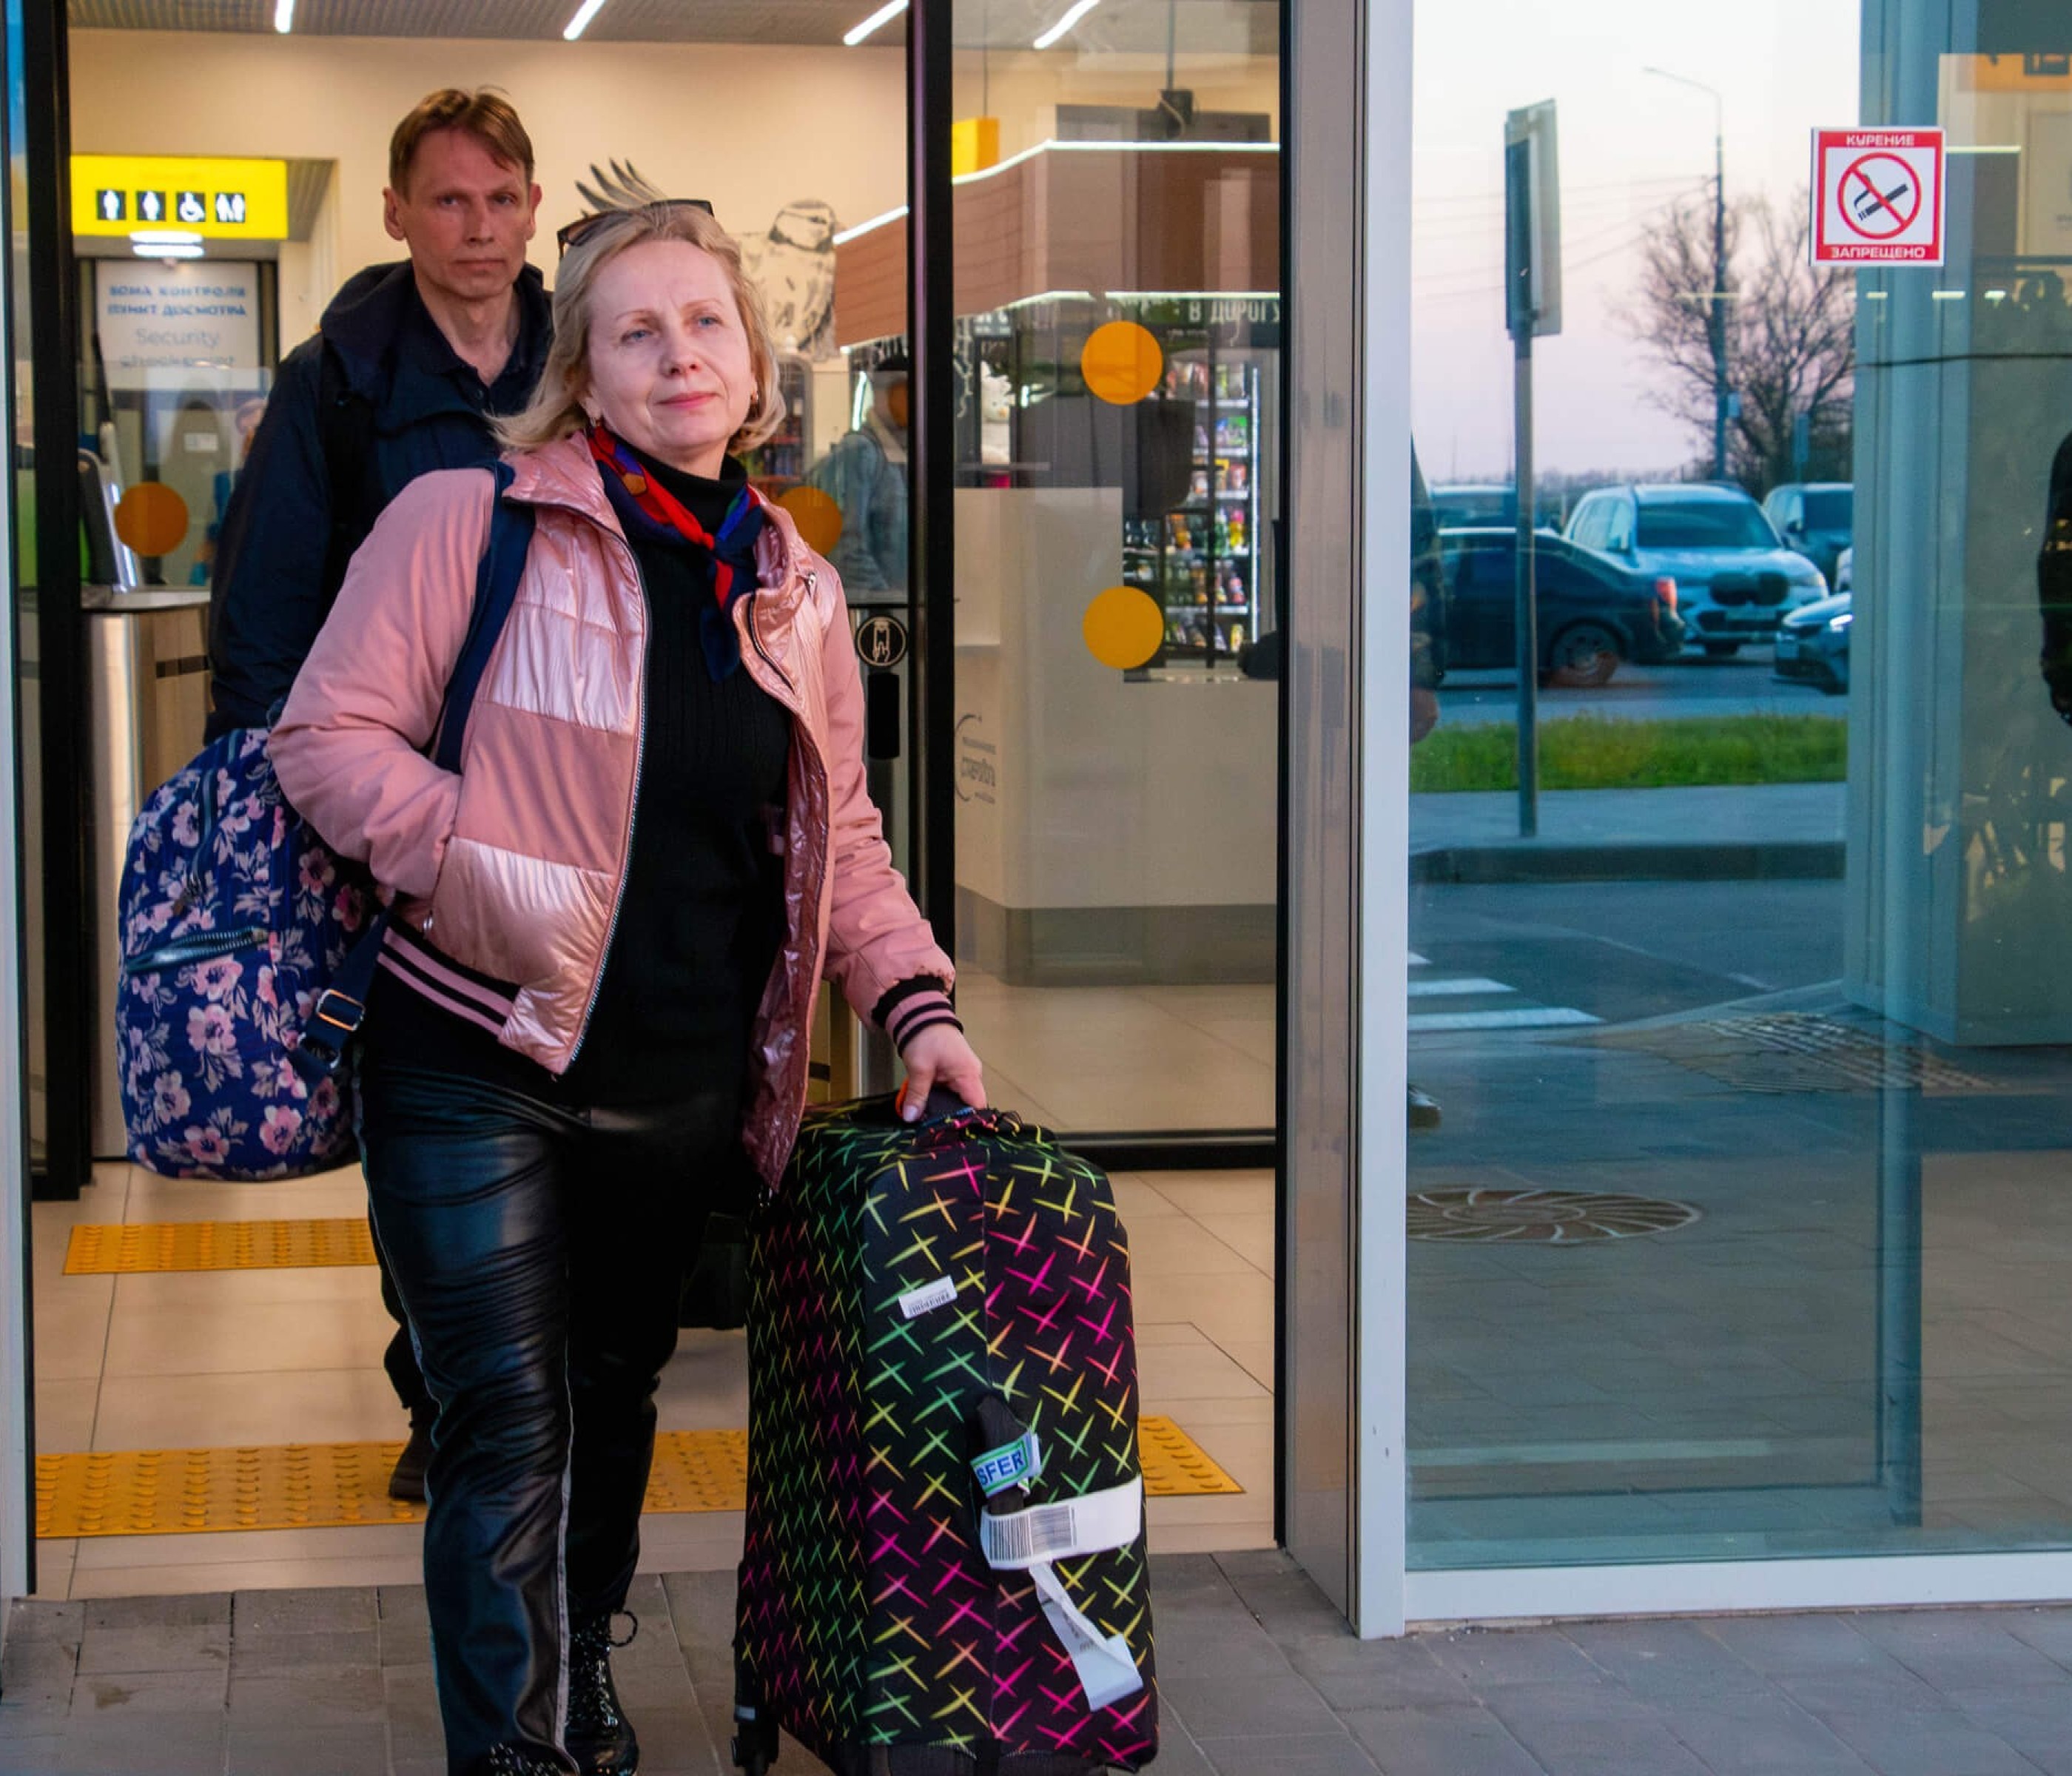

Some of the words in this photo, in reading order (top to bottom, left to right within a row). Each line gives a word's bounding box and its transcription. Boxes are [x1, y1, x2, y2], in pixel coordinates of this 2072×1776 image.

[1846, 133, 1915, 147] КУРЕНИЕ
[1830, 246, 1926, 260] ЗАПРЕЩЕНО
[1189, 299, 1202, 323] В
[135, 327, 221, 349] Security
